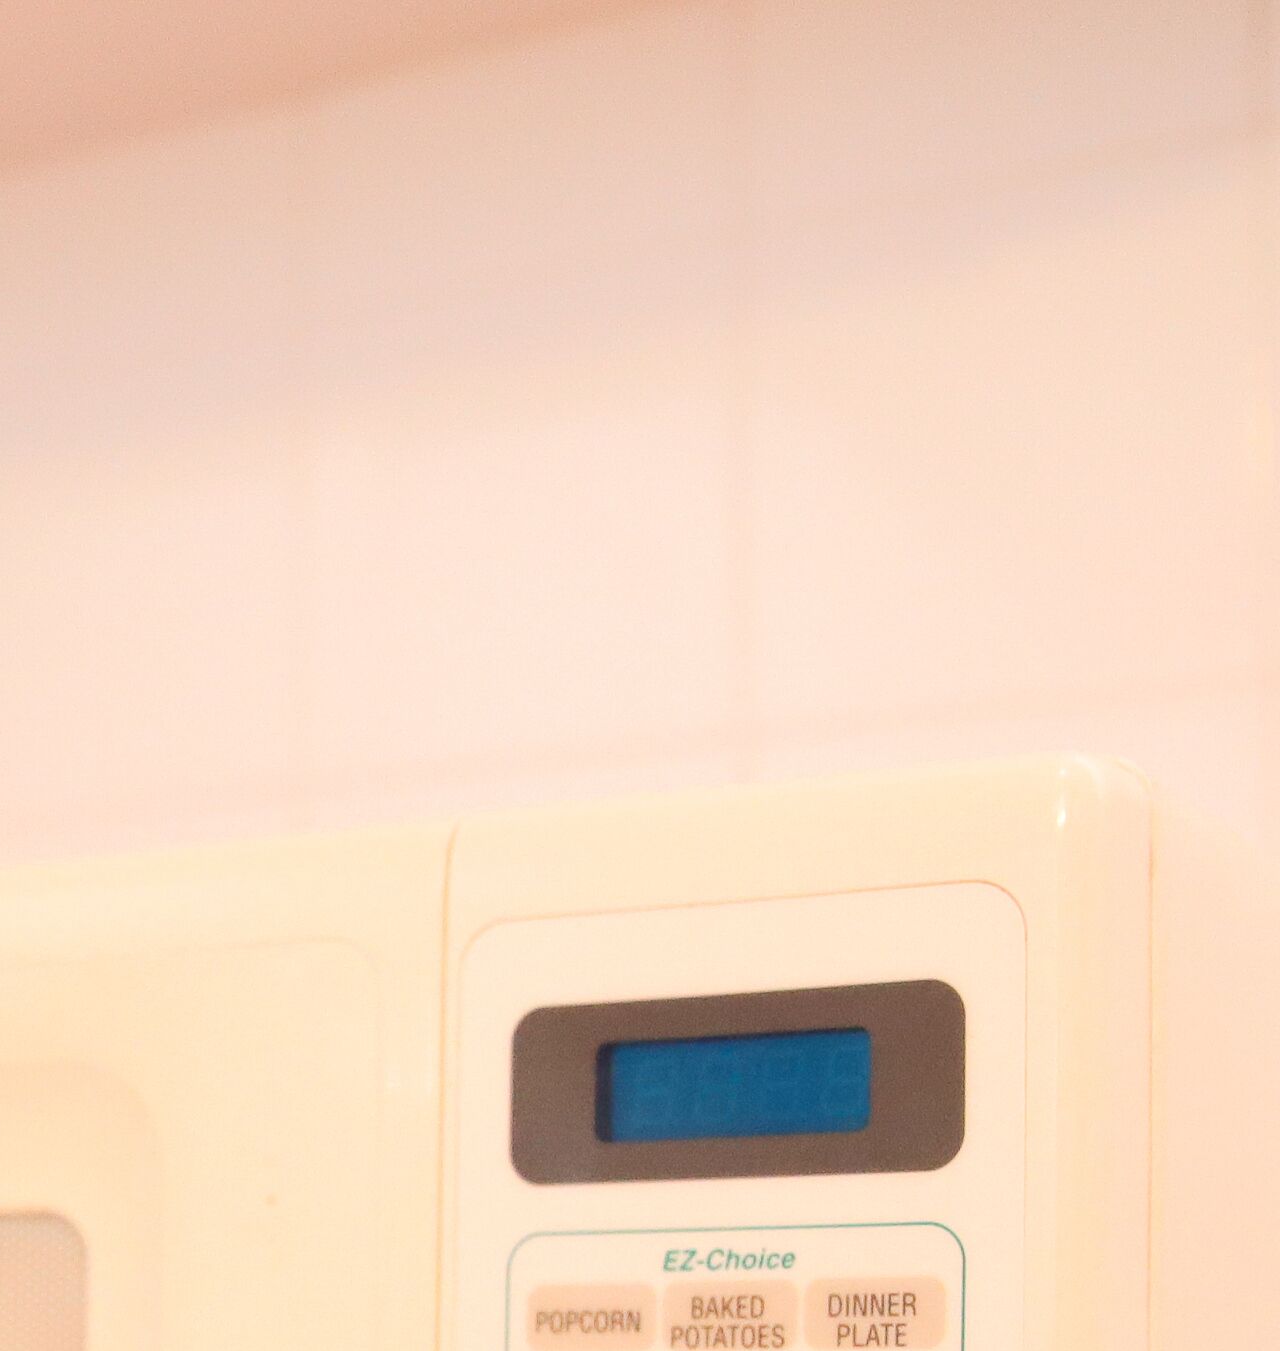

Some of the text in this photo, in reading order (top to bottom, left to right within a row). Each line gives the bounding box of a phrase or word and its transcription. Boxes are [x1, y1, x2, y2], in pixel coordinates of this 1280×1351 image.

[663, 1248, 796, 1272] EZ-Choice
[691, 1296, 764, 1318] BAKED
[828, 1293, 917, 1316] DINNER
[536, 1311, 641, 1333] POPCORN
[670, 1325, 786, 1349] POTATOES
[837, 1324, 907, 1347] PLATE
